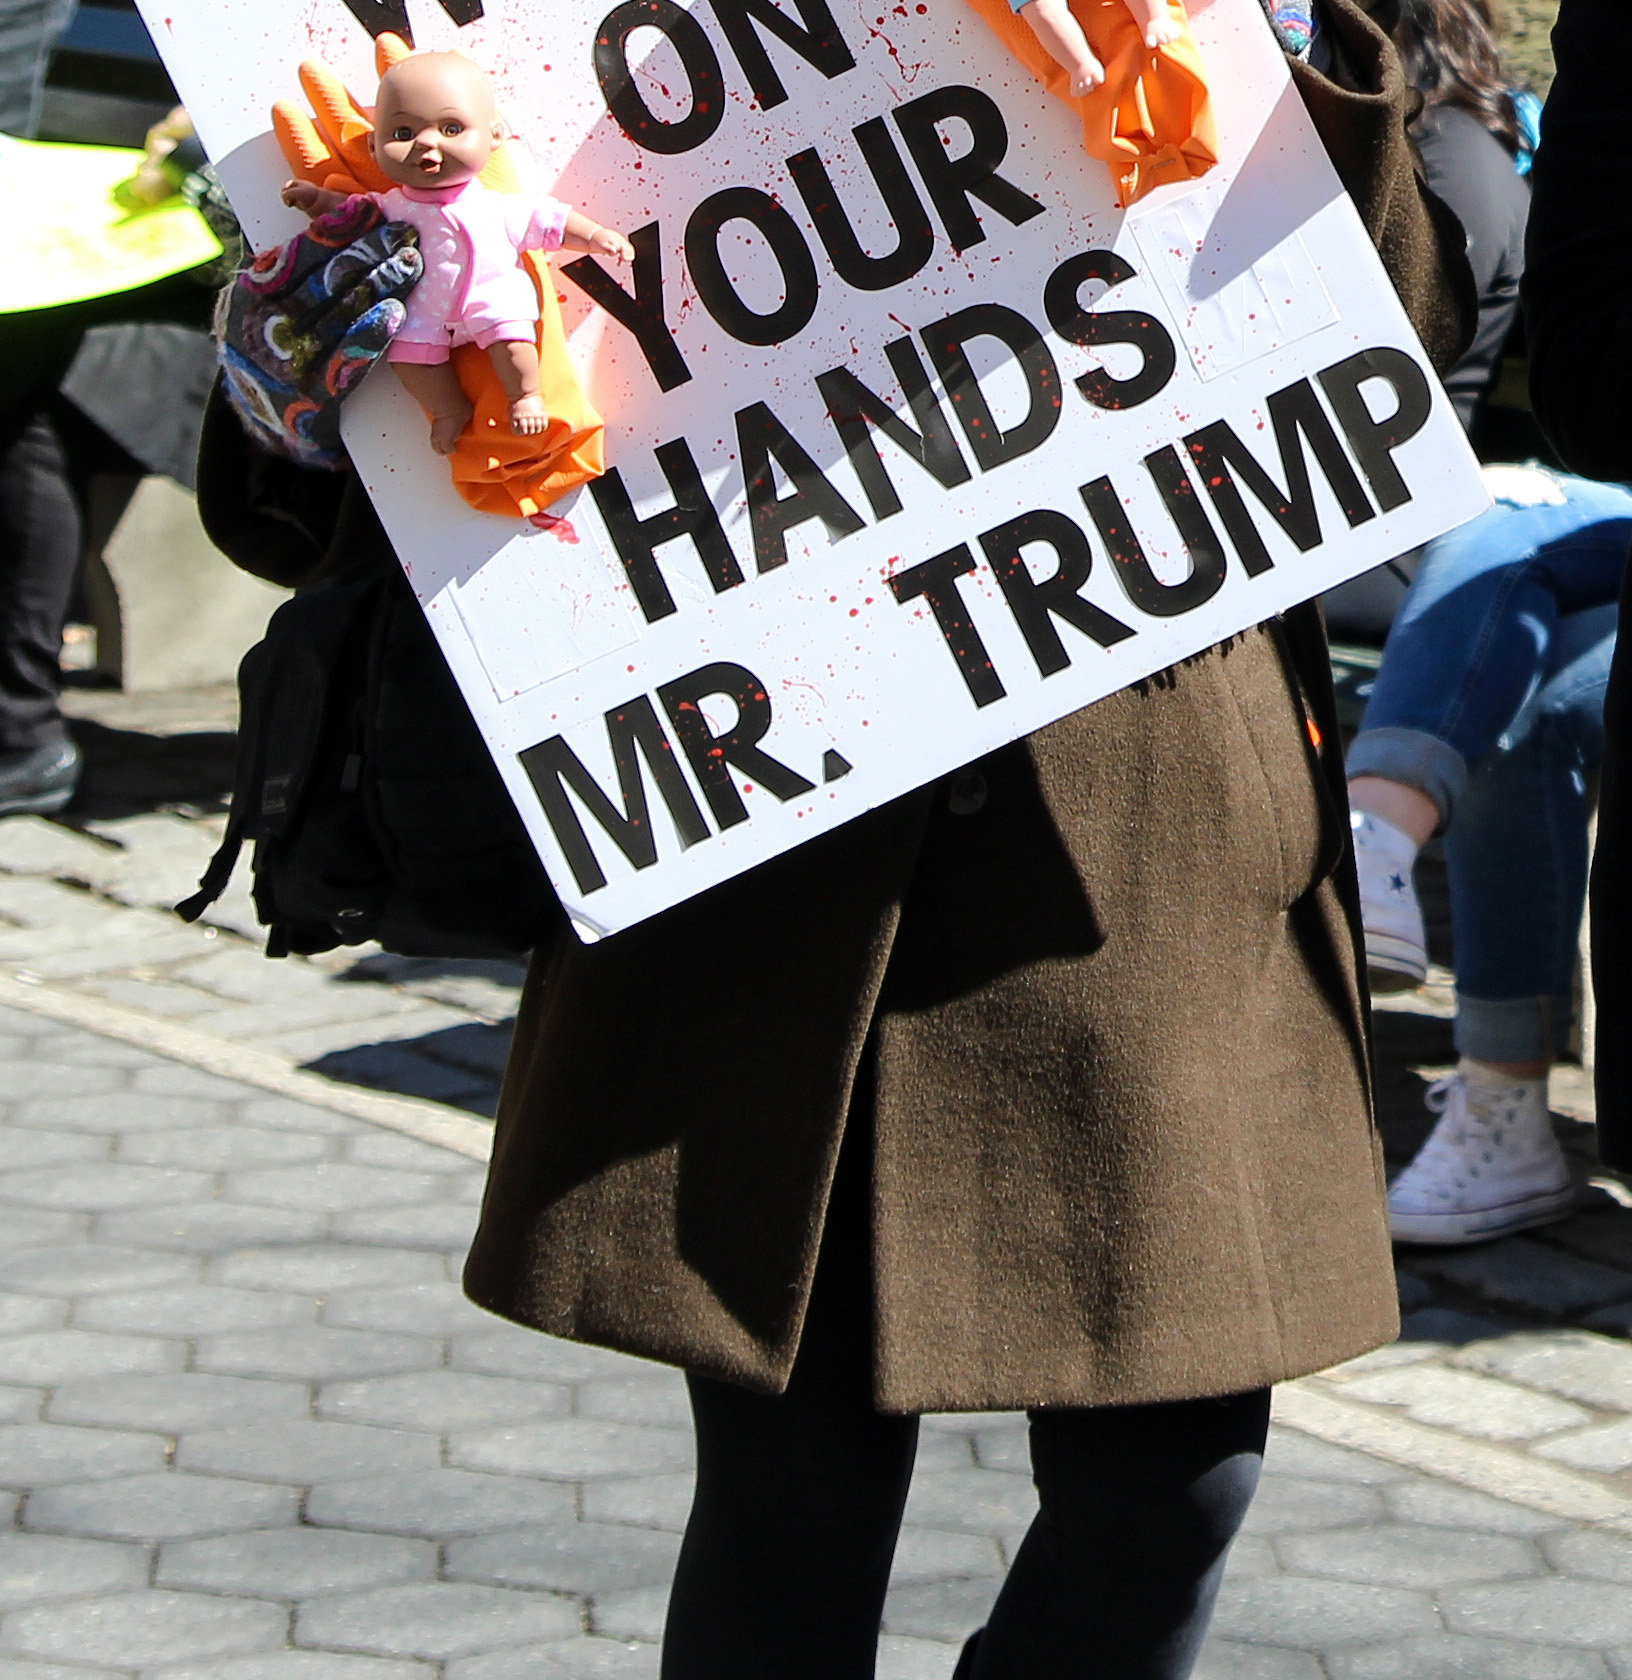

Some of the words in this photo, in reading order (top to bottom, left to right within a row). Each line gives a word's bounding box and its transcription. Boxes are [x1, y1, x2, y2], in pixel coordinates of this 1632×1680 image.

[560, 83, 1047, 396] YOUR
[516, 659, 854, 898] MR.
[886, 345, 1433, 711] TRUMP
[586, 248, 1178, 626] HANDS
